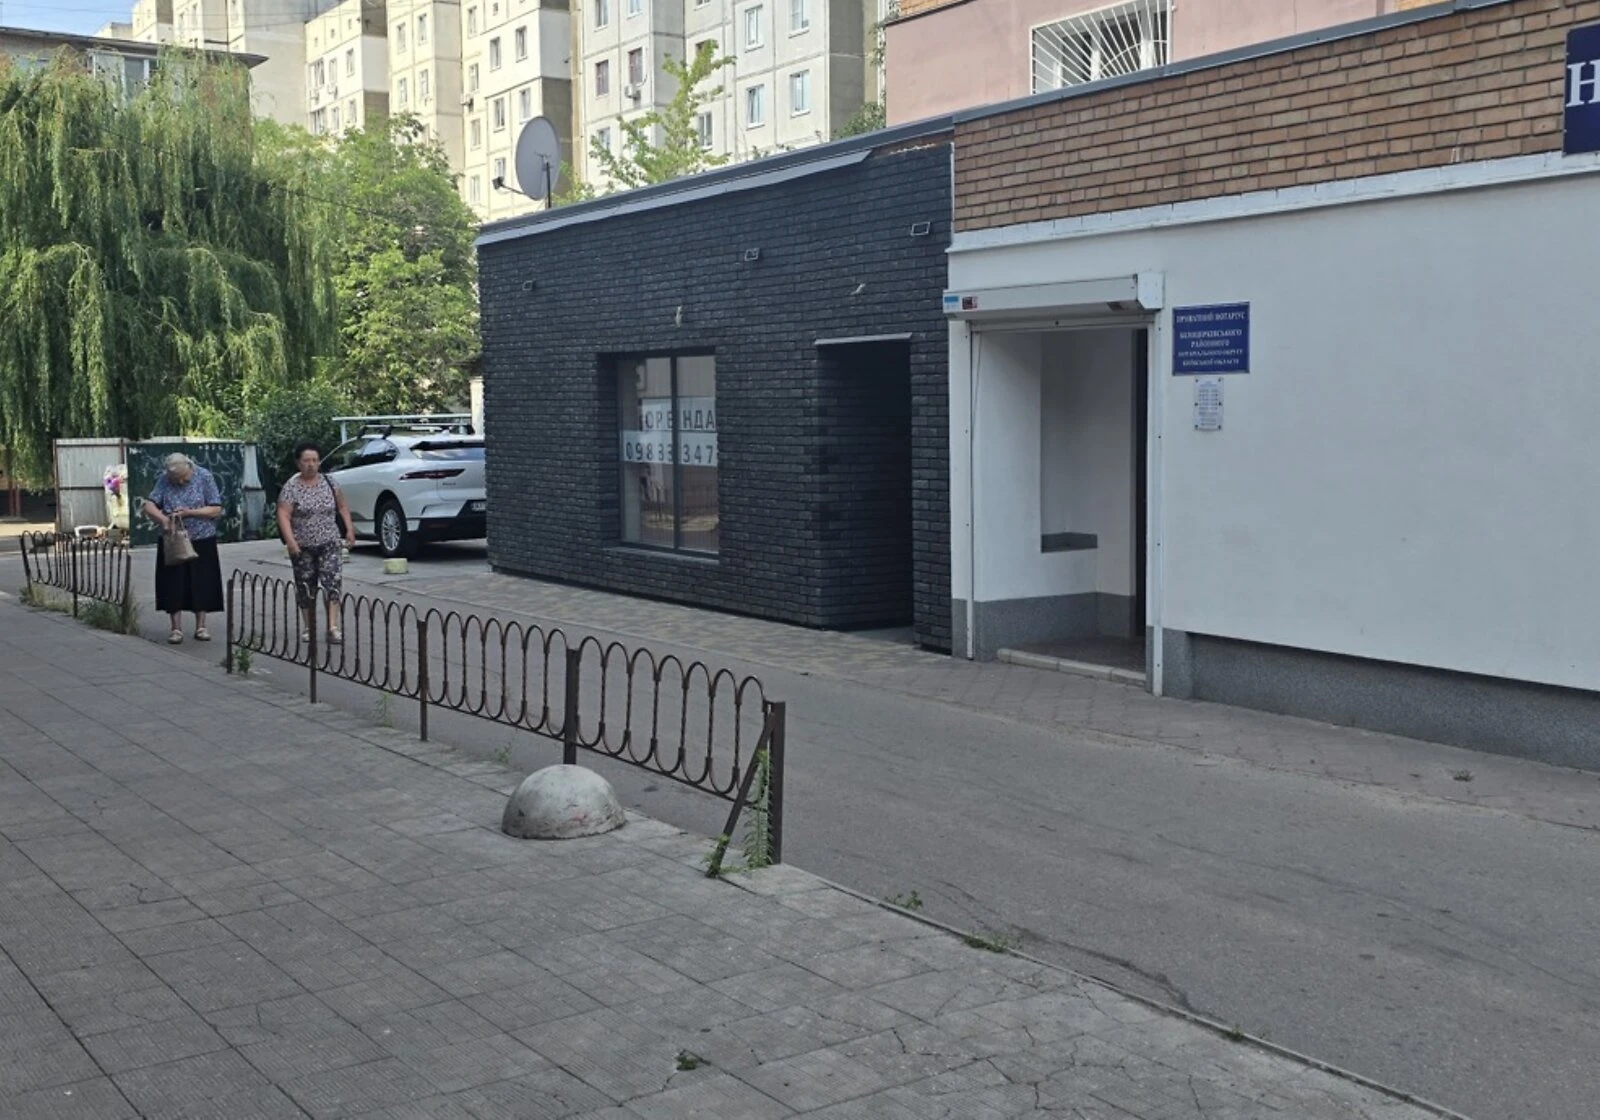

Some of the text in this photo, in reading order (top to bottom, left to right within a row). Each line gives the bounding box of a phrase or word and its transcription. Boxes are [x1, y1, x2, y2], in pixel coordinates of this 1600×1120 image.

[1176, 311, 1246, 323] ПРИВАТНИЙ НОТАРІУС
[645, 410, 715, 429] ОРЕНДА
